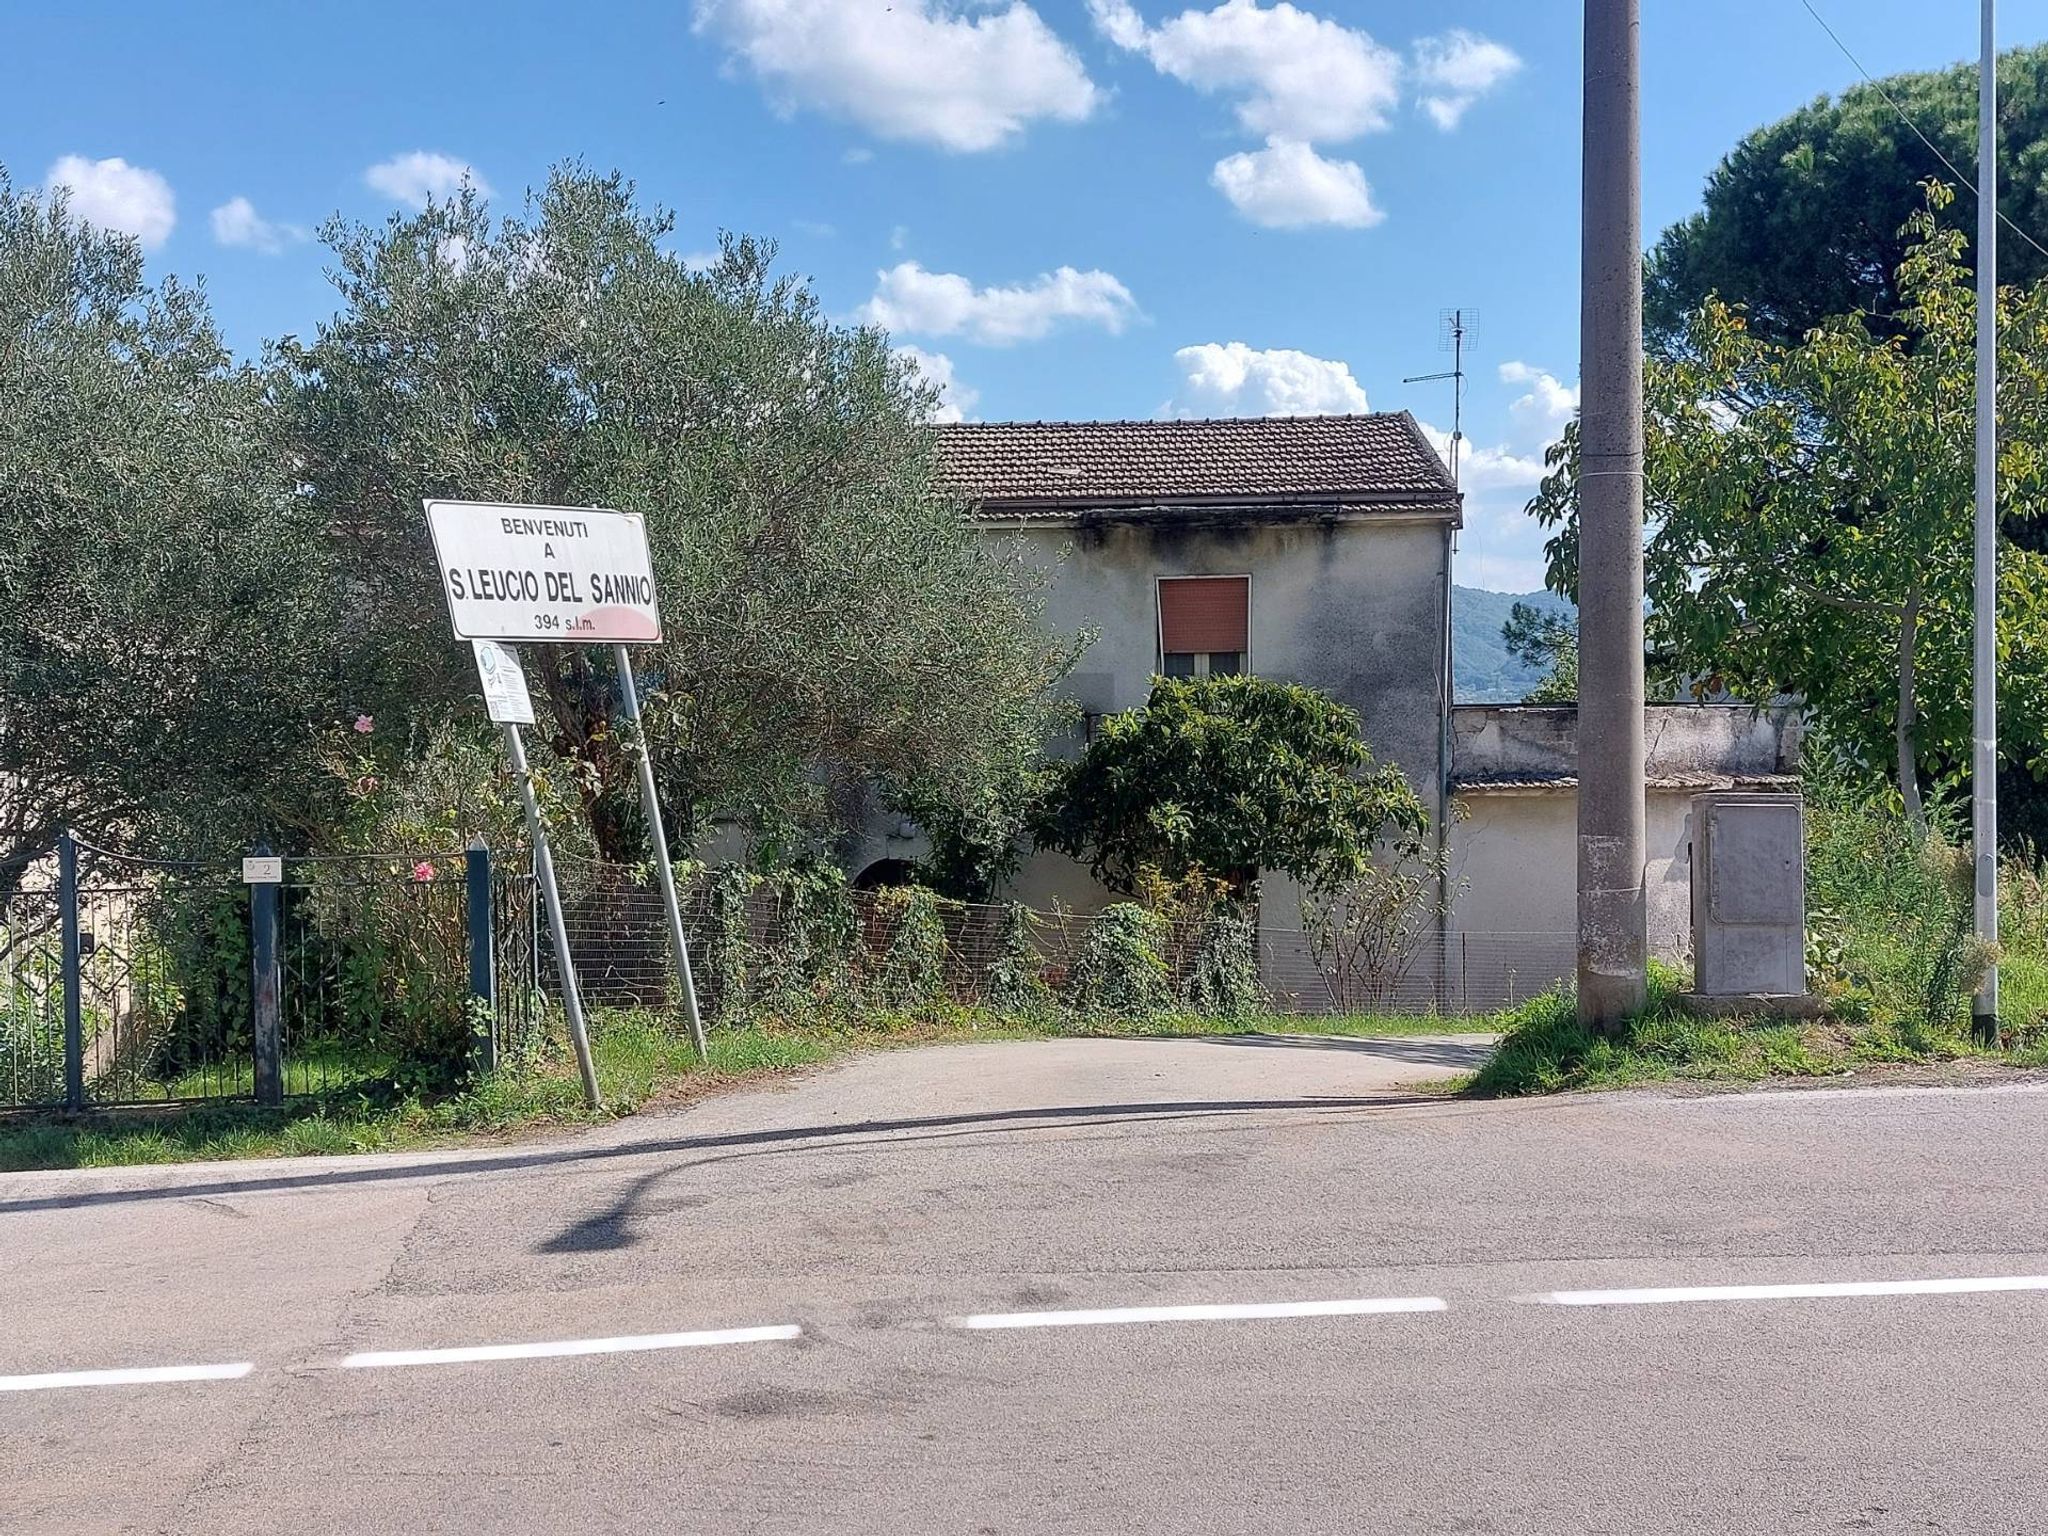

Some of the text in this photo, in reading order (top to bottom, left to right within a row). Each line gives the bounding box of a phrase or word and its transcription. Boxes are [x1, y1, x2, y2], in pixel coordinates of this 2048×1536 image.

[501, 518, 589, 538] BENVENUTI
[544, 542, 556, 559] A
[544, 571, 583, 603] DEL
[590, 573, 652, 605] SANNIO
[534, 614, 596, 631] 394 s.l.m.
[263, 864, 271, 875] 2
